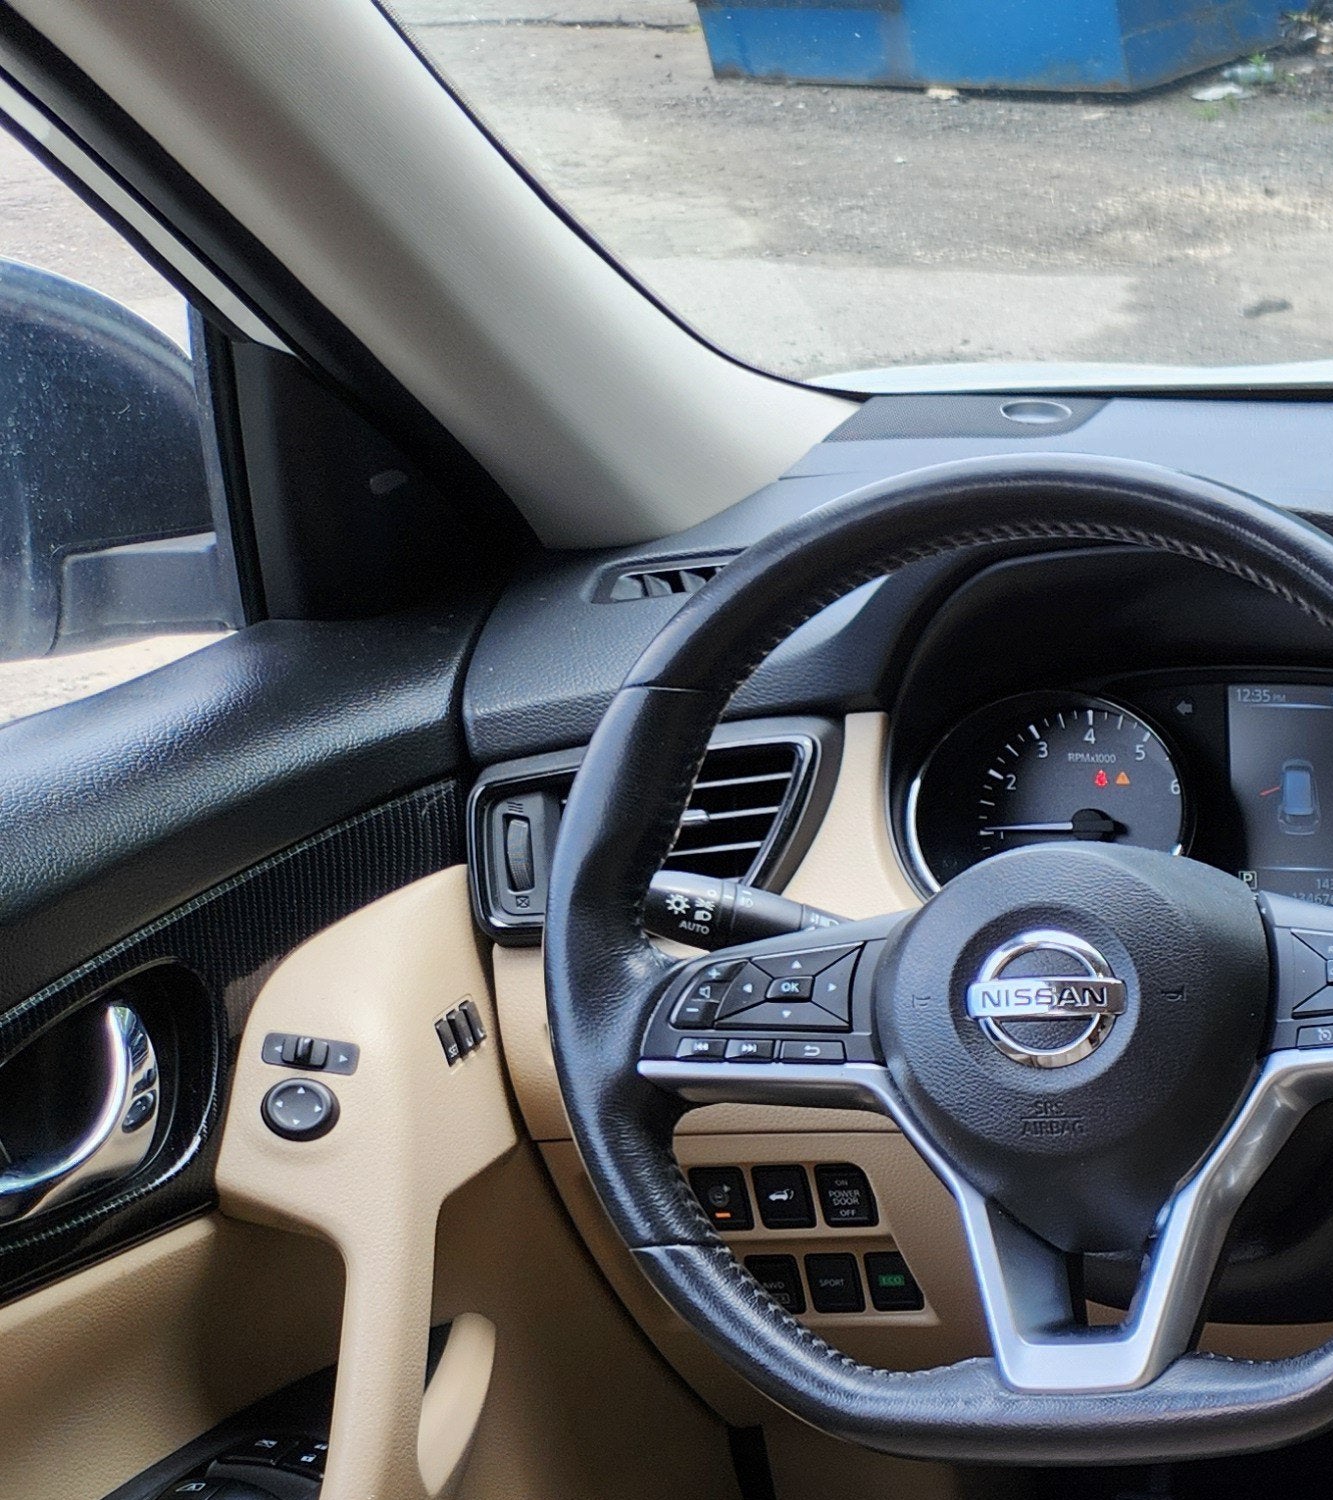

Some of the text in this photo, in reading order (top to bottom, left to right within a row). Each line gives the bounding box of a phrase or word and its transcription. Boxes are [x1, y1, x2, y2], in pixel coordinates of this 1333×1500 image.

[1237, 689, 1270, 702] 12:35
[1084, 728, 1096, 744] 4
[1038, 741, 1049, 758] 3
[1135, 744, 1146, 761] 5
[1067, 752, 1116, 764] RPMx1000
[1006, 774, 1017, 790] 2
[1171, 779, 1180, 795] 6
[1243, 872, 1253, 882] P
[679, 920, 710, 935] AUTO
[781, 982, 799, 993] OK
[981, 986, 1108, 1009] NISSAN
[1033, 1101, 1065, 1116] SRS
[1022, 1121, 1084, 1136] AIRBAG
[828, 1189, 860, 1198] POWER
[832, 1197, 860, 1206] DOOR
[840, 1208, 855, 1217] OFF
[819, 1278, 844, 1287] SPORT
